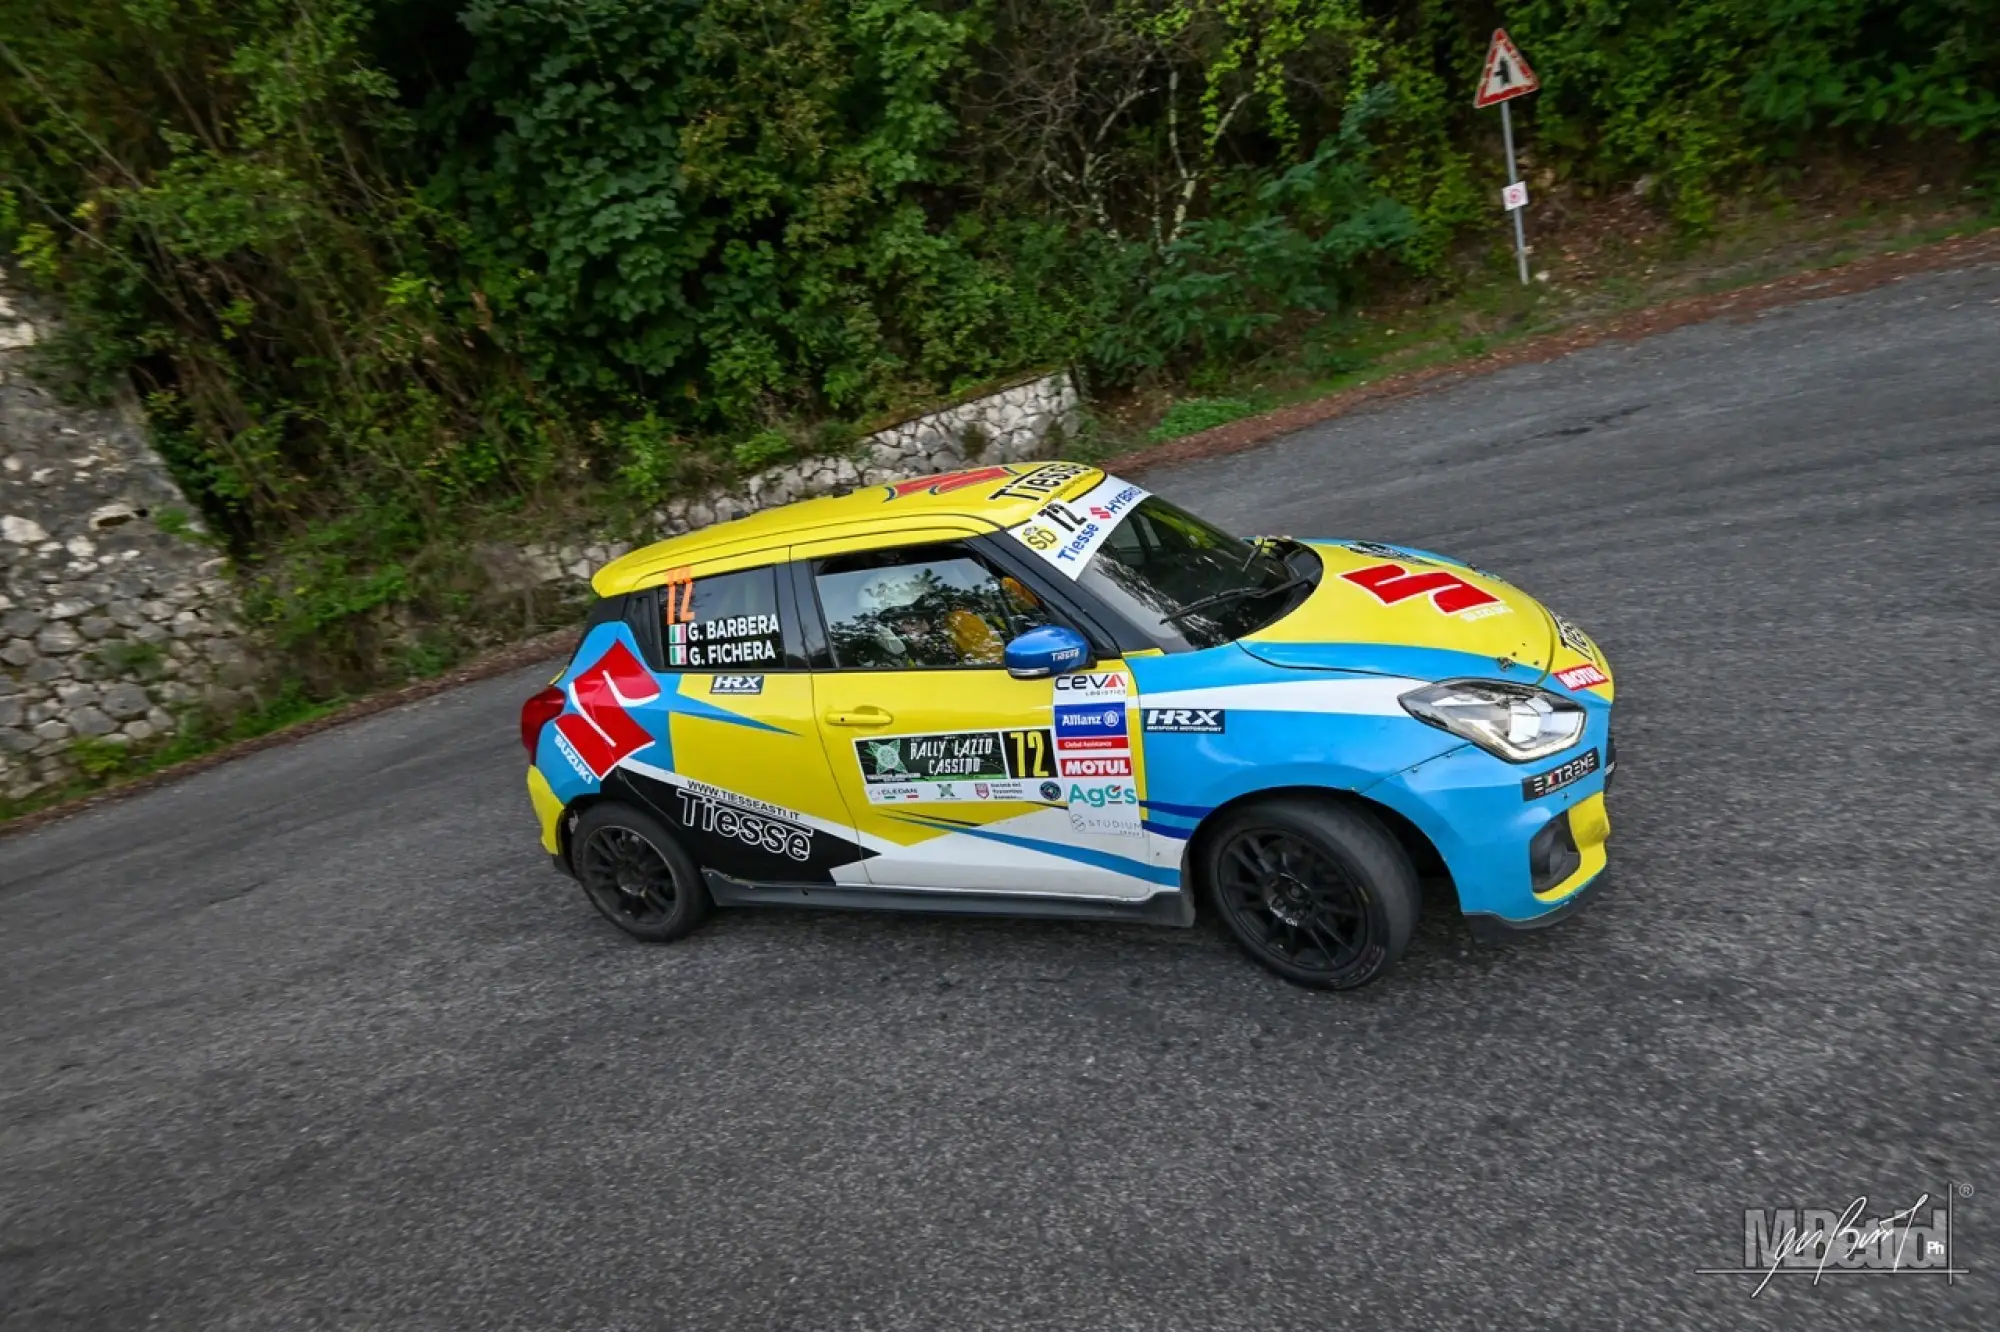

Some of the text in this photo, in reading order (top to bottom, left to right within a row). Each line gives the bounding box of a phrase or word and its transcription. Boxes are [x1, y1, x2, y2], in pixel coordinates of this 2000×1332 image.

[1037, 502, 1087, 532] 72
[1057, 522, 1100, 561] Tiesse
[688, 614, 780, 641] G. BARBERA
[689, 640, 776, 665] G. FICHERA
[713, 676, 761, 688] HRX
[1557, 666, 1605, 690] MOTUL
[1062, 714, 1102, 727] Allianz
[1146, 709, 1220, 726] HRX
[554, 734, 593, 785] SUZUKI
[910, 740, 946, 761] RALLY
[1010, 731, 1049, 777] 72
[1065, 759, 1129, 776] MOTUL
[1069, 784, 1137, 807] Agos
[676, 787, 815, 862] Tiesse
